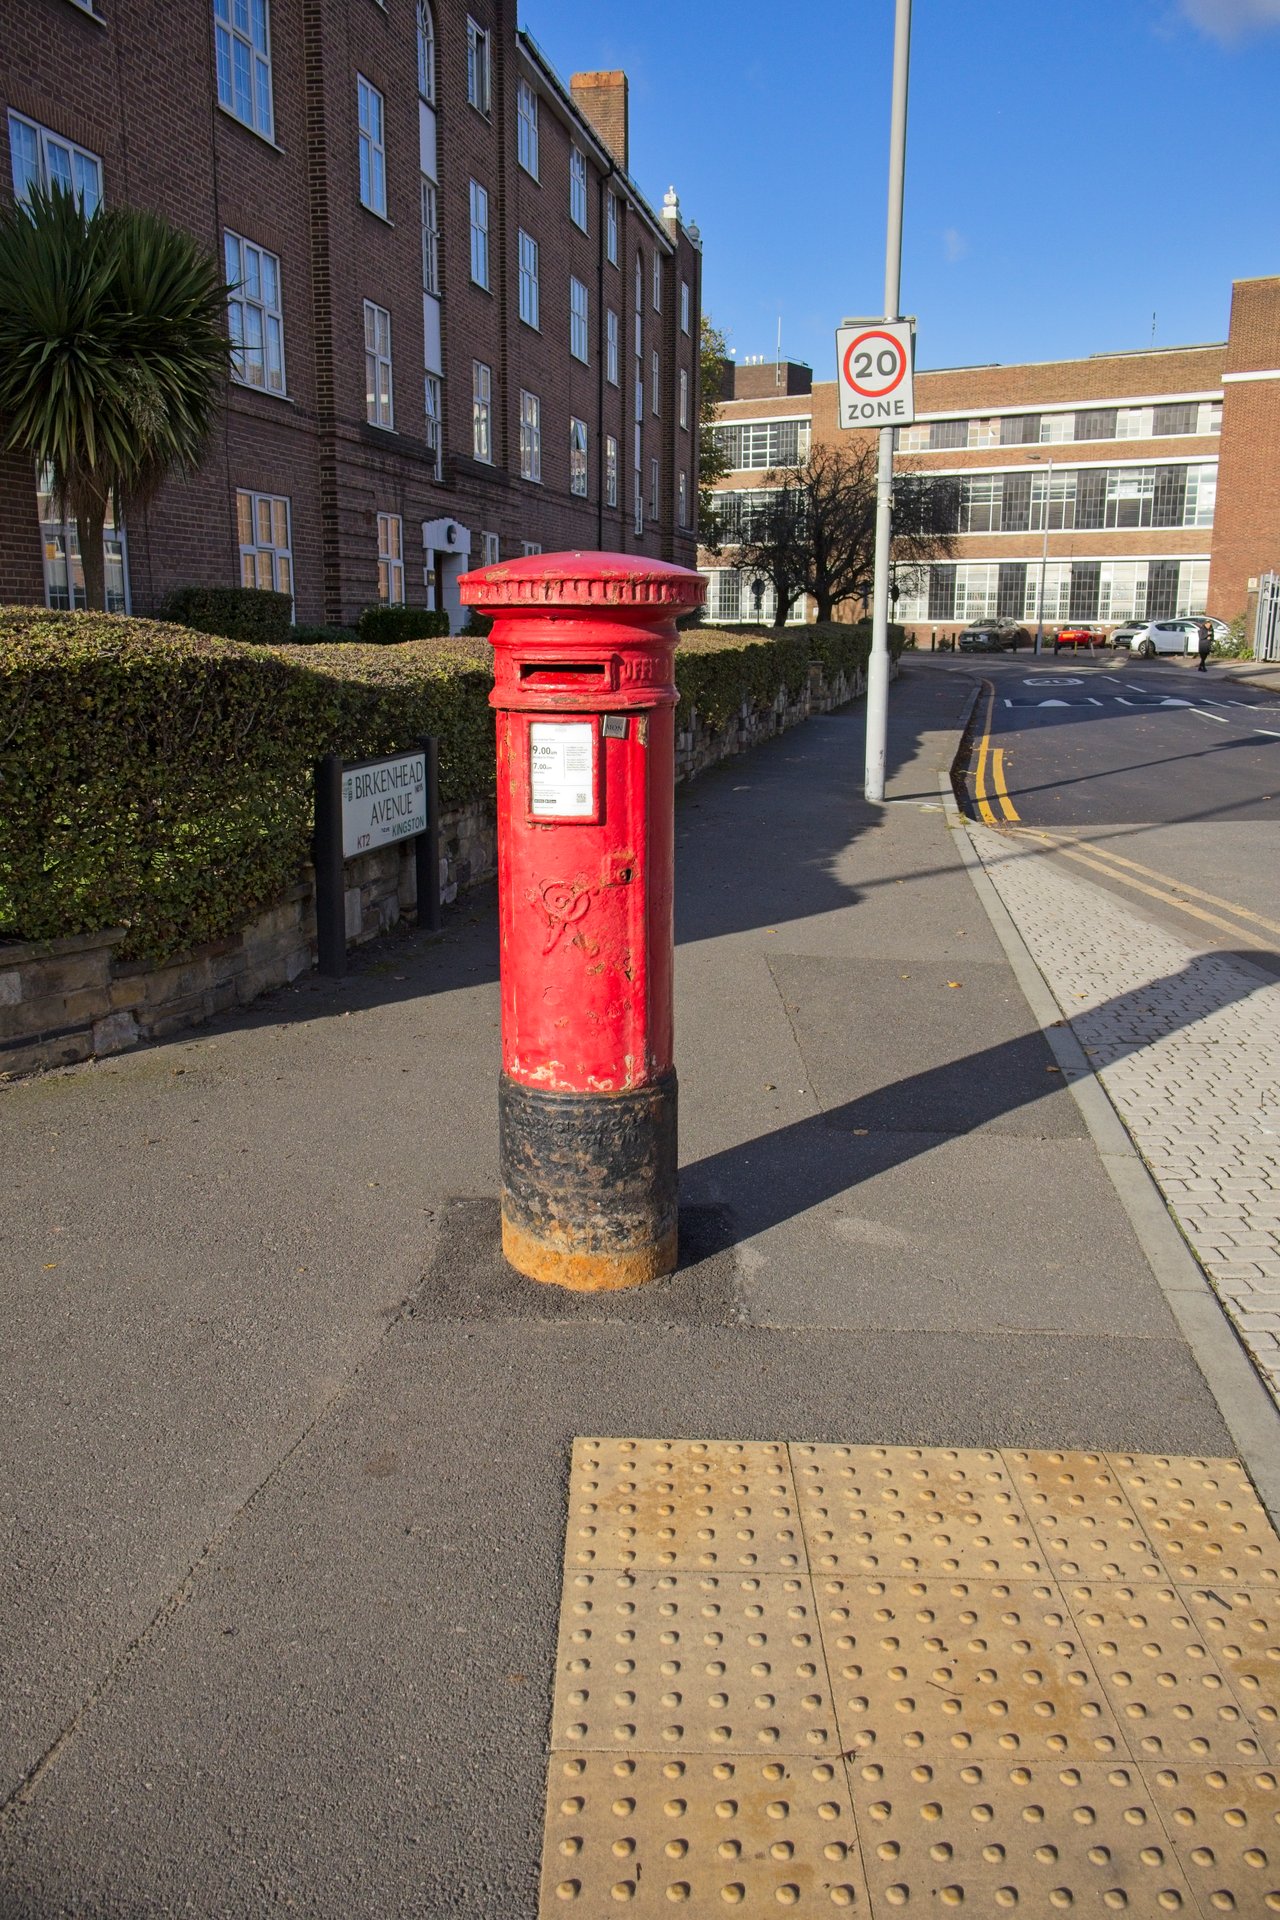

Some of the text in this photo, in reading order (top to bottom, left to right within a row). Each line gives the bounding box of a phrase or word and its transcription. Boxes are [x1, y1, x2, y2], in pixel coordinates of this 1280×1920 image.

[854, 349, 898, 379] 20
[847, 399, 905, 420] ZONE
[605, 723, 623, 732] MON
[355, 761, 424, 800] BIRKENHEAD
[370, 793, 413, 826] AVENUE
[392, 816, 424, 837] KINGSTON
[357, 833, 371, 849] KT2
